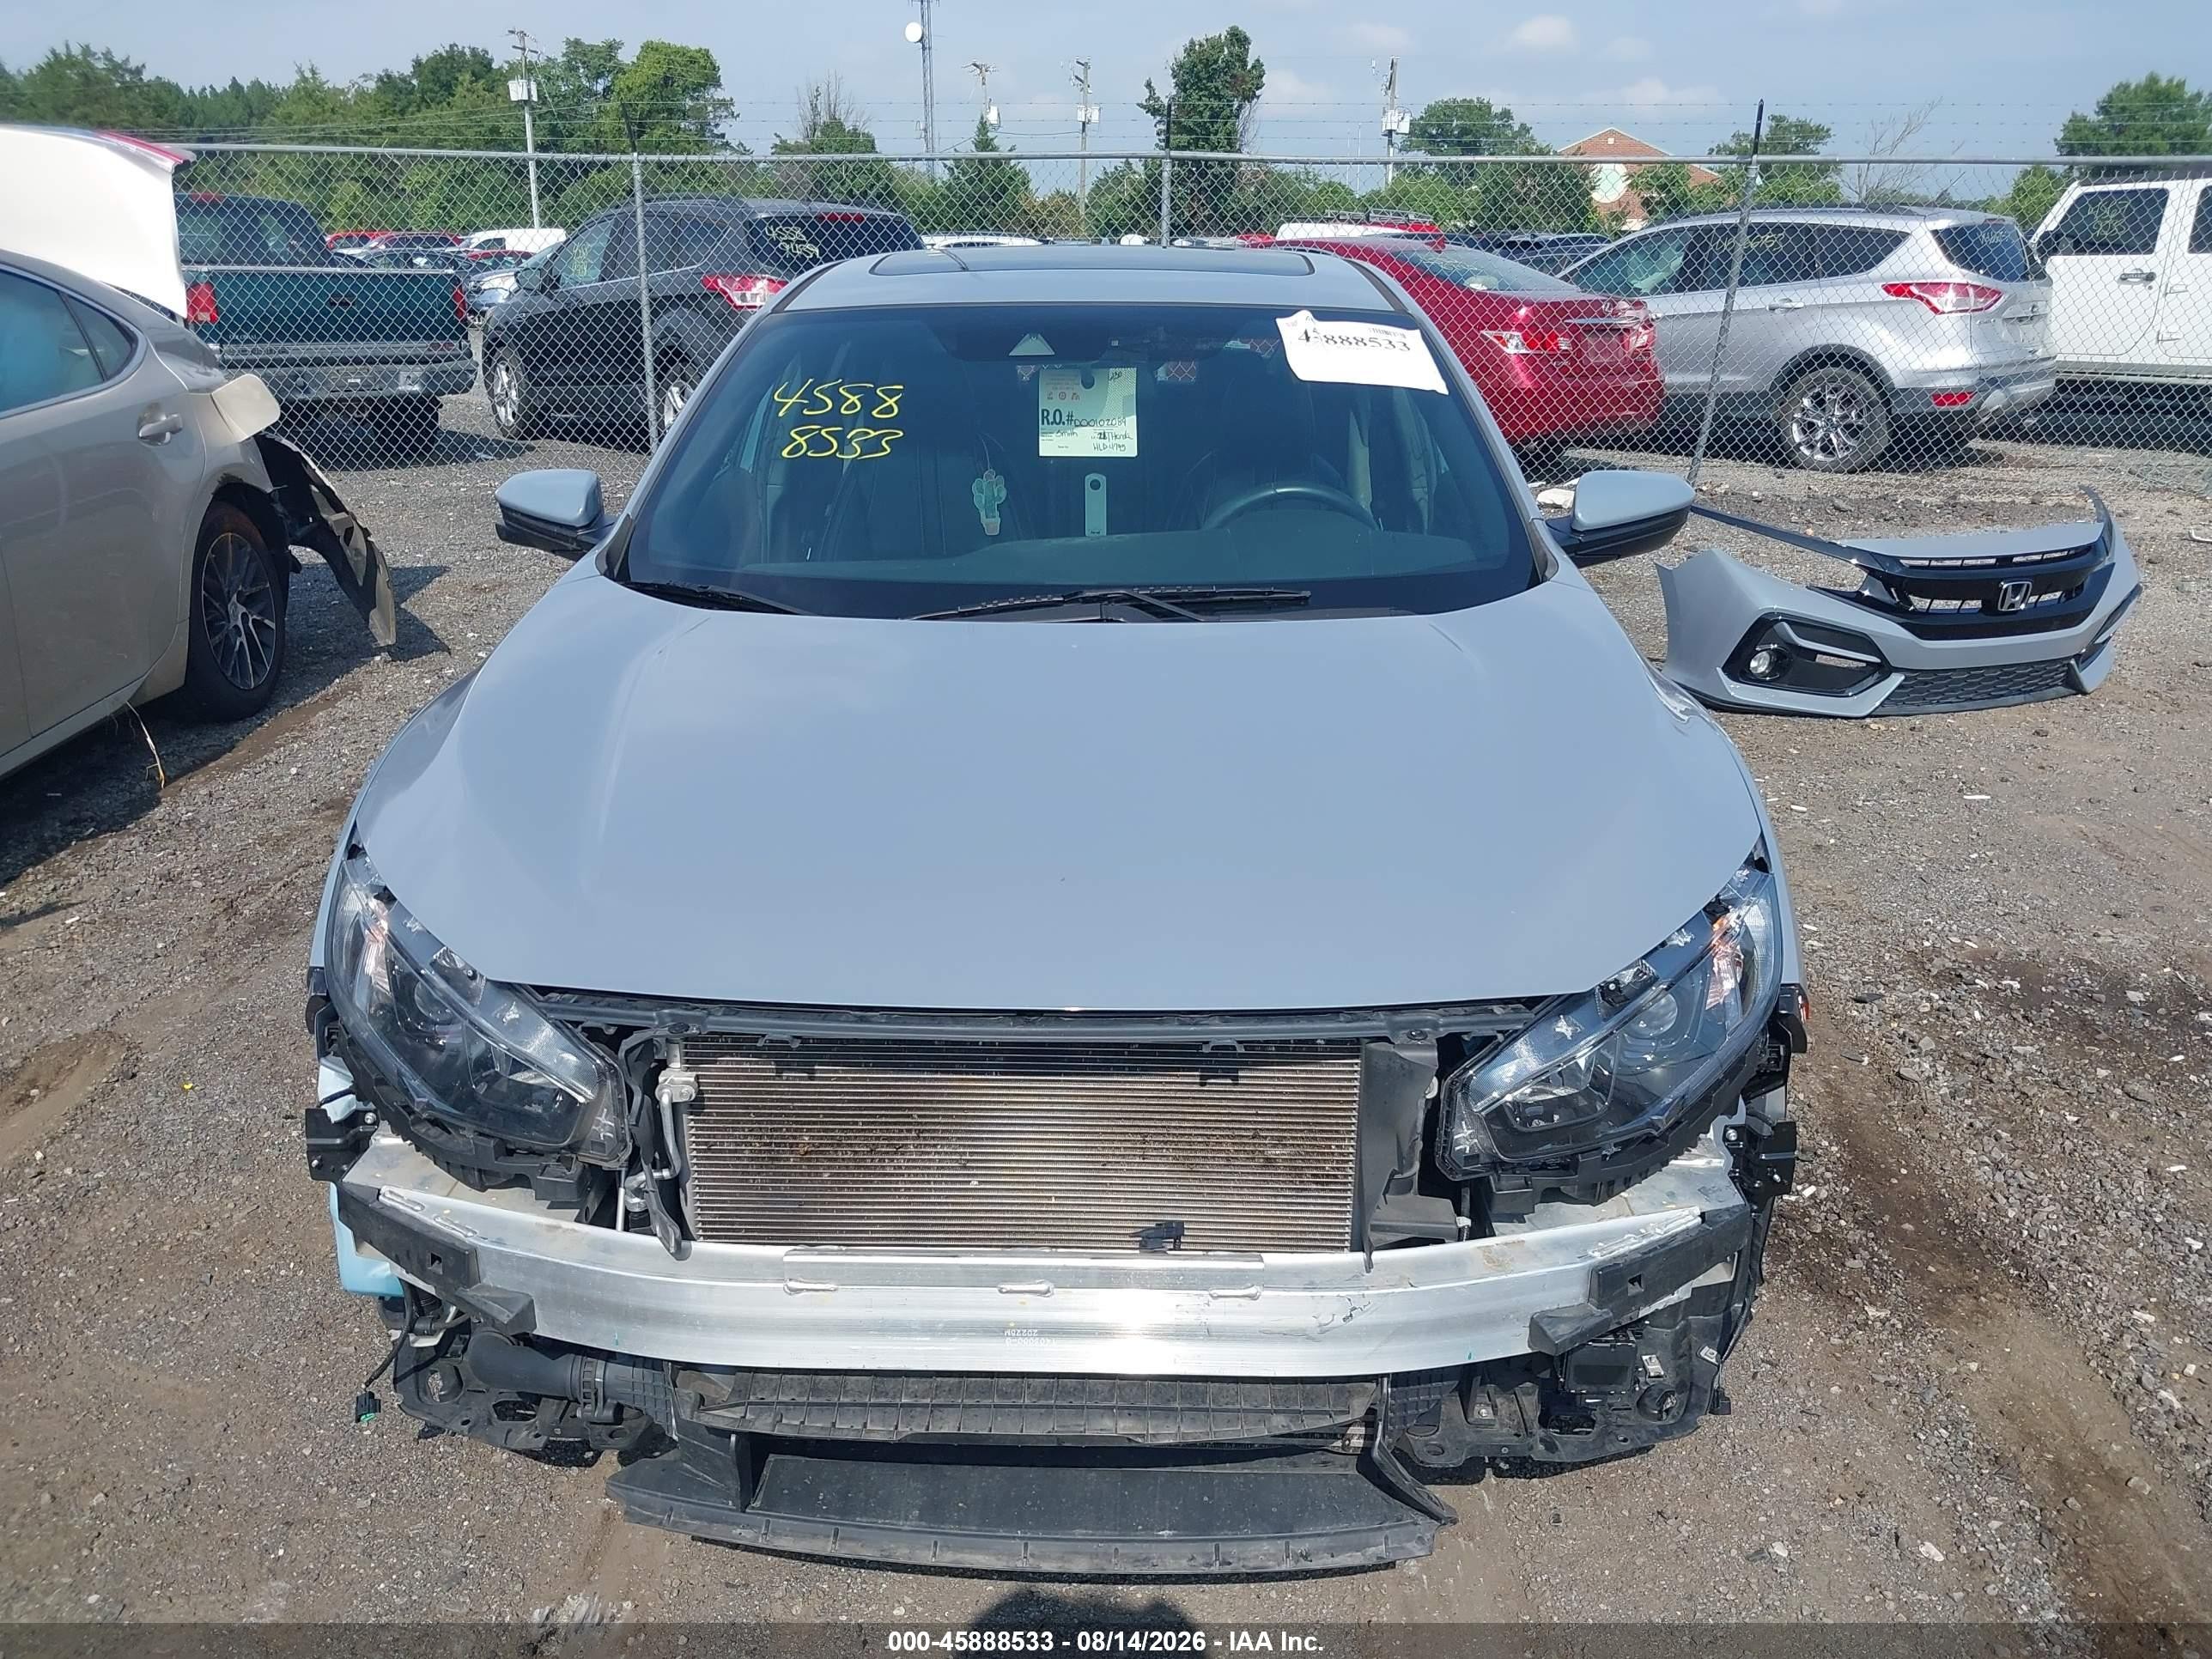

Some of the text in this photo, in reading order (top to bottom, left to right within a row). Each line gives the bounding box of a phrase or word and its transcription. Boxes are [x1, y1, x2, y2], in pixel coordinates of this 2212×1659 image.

[1298, 327, 1411, 351] 45888533
[773, 378, 904, 418] 4588
[781, 425, 905, 460] 8533
